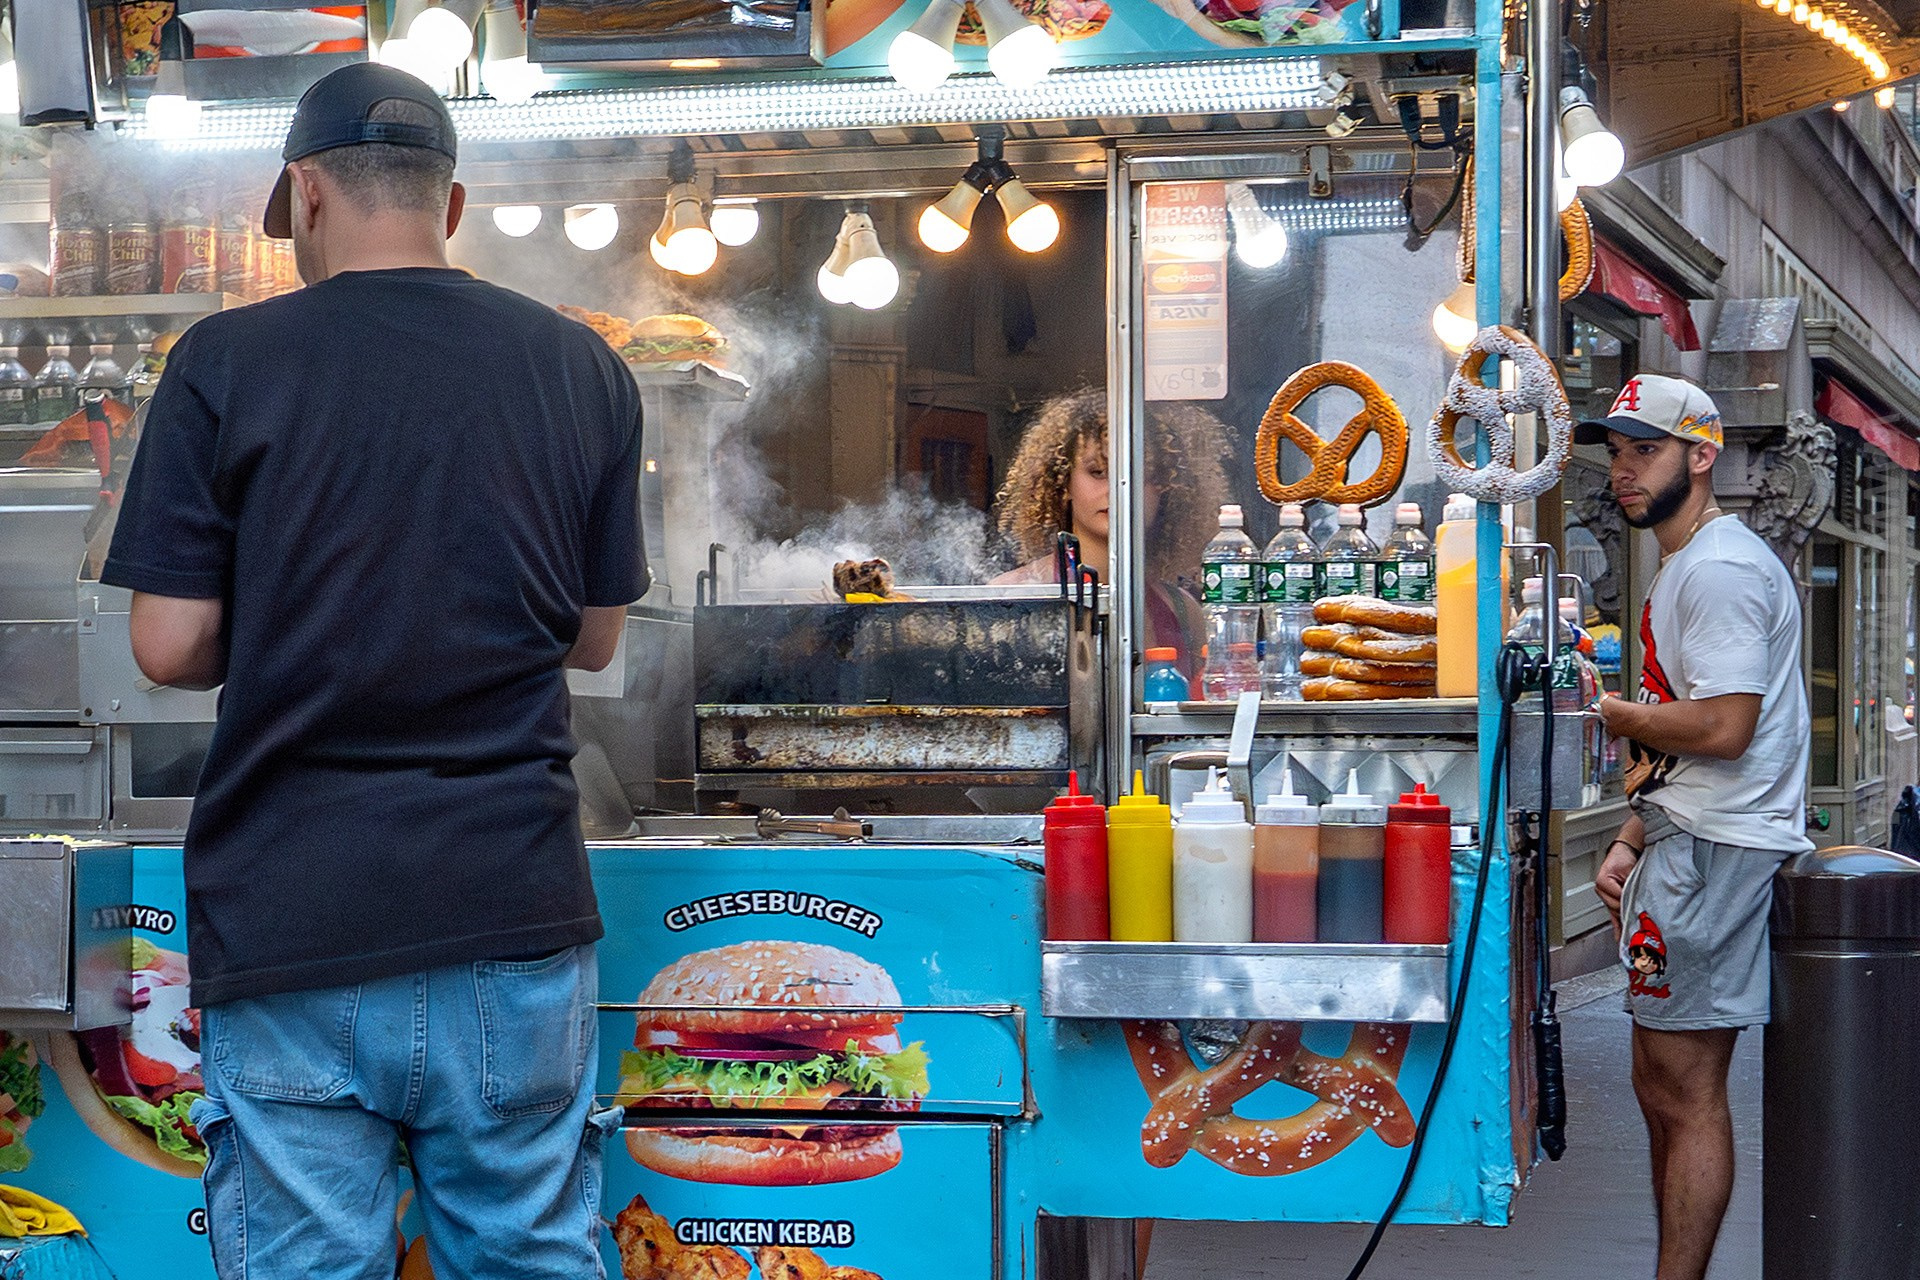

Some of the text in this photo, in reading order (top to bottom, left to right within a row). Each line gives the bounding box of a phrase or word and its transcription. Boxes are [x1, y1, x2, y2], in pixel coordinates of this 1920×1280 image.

[1607, 379, 1642, 416] A
[133, 907, 174, 932] YRO
[665, 892, 881, 937] CHEESEBURGER
[677, 1221, 852, 1245] CHICKEN KEBAB
